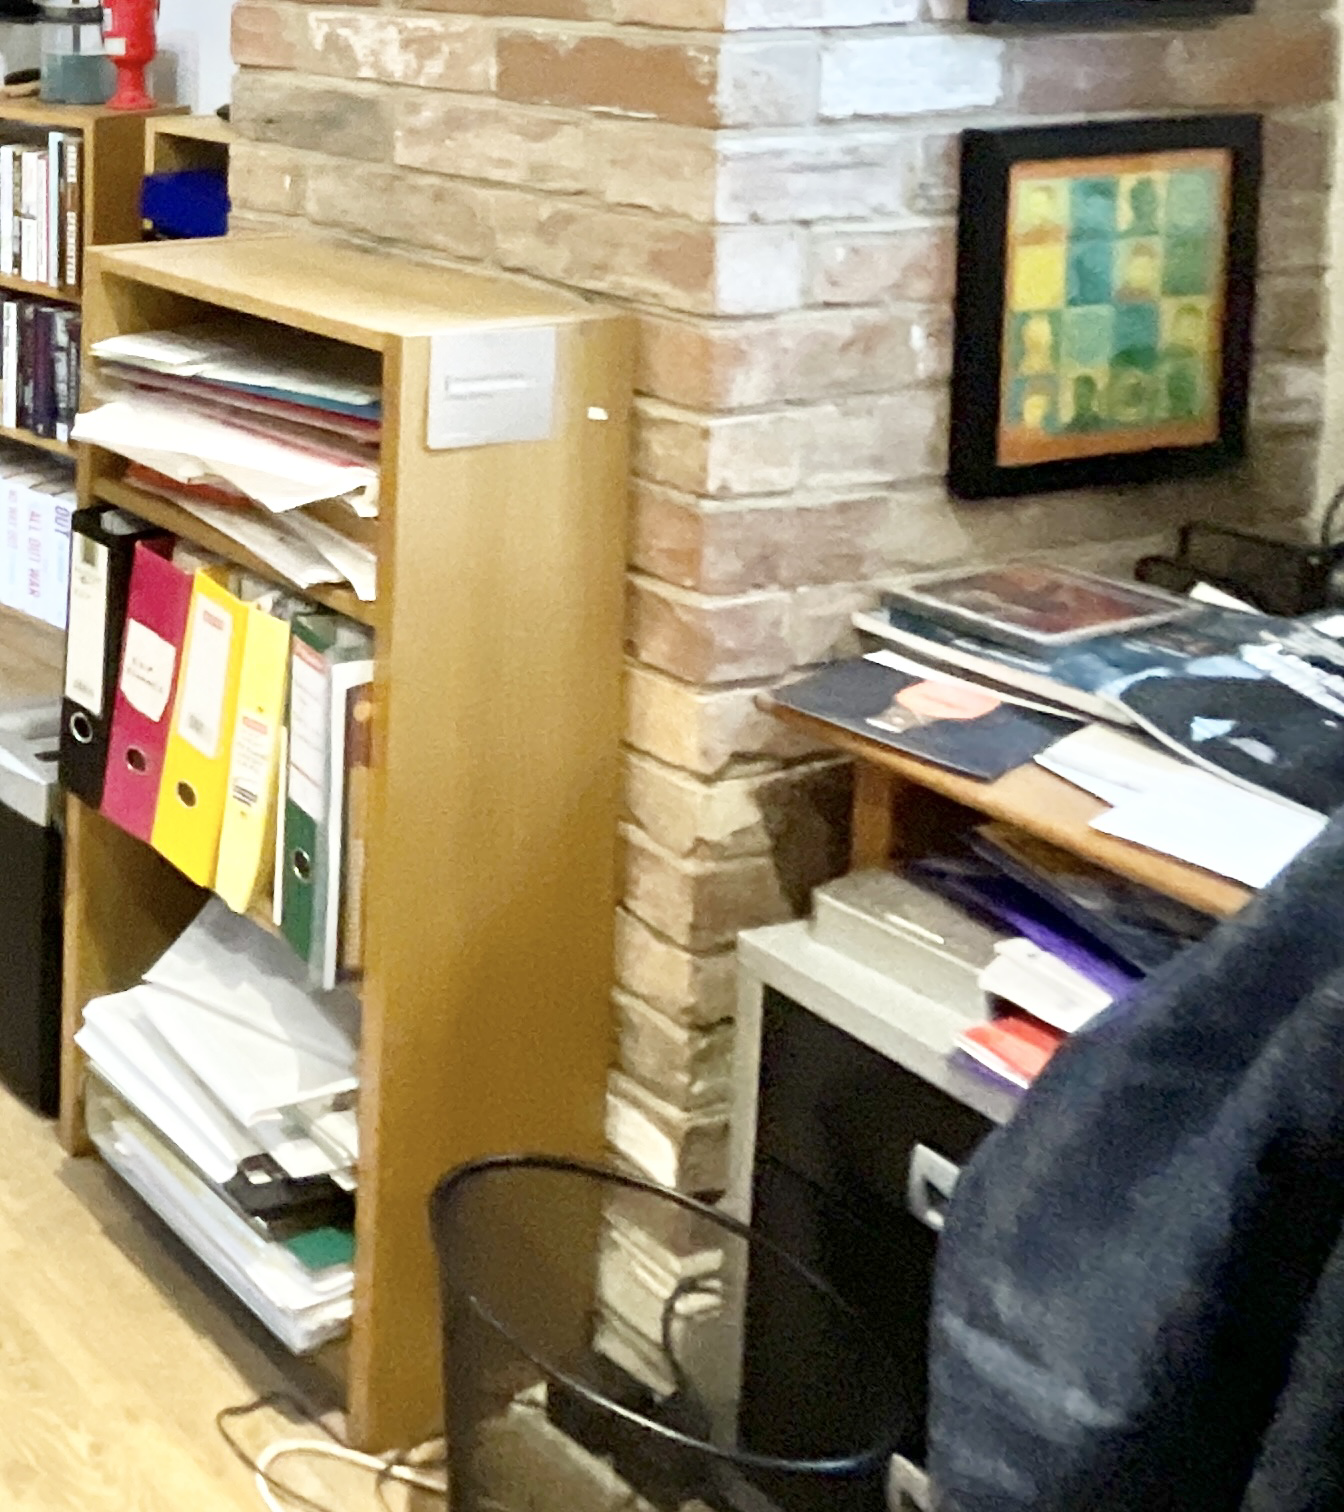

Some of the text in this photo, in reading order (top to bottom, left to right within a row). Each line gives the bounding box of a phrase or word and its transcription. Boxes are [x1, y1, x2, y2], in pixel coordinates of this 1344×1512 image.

[54, 504, 71, 539] OUT
[27, 510, 43, 599] ALL OUT WAR
